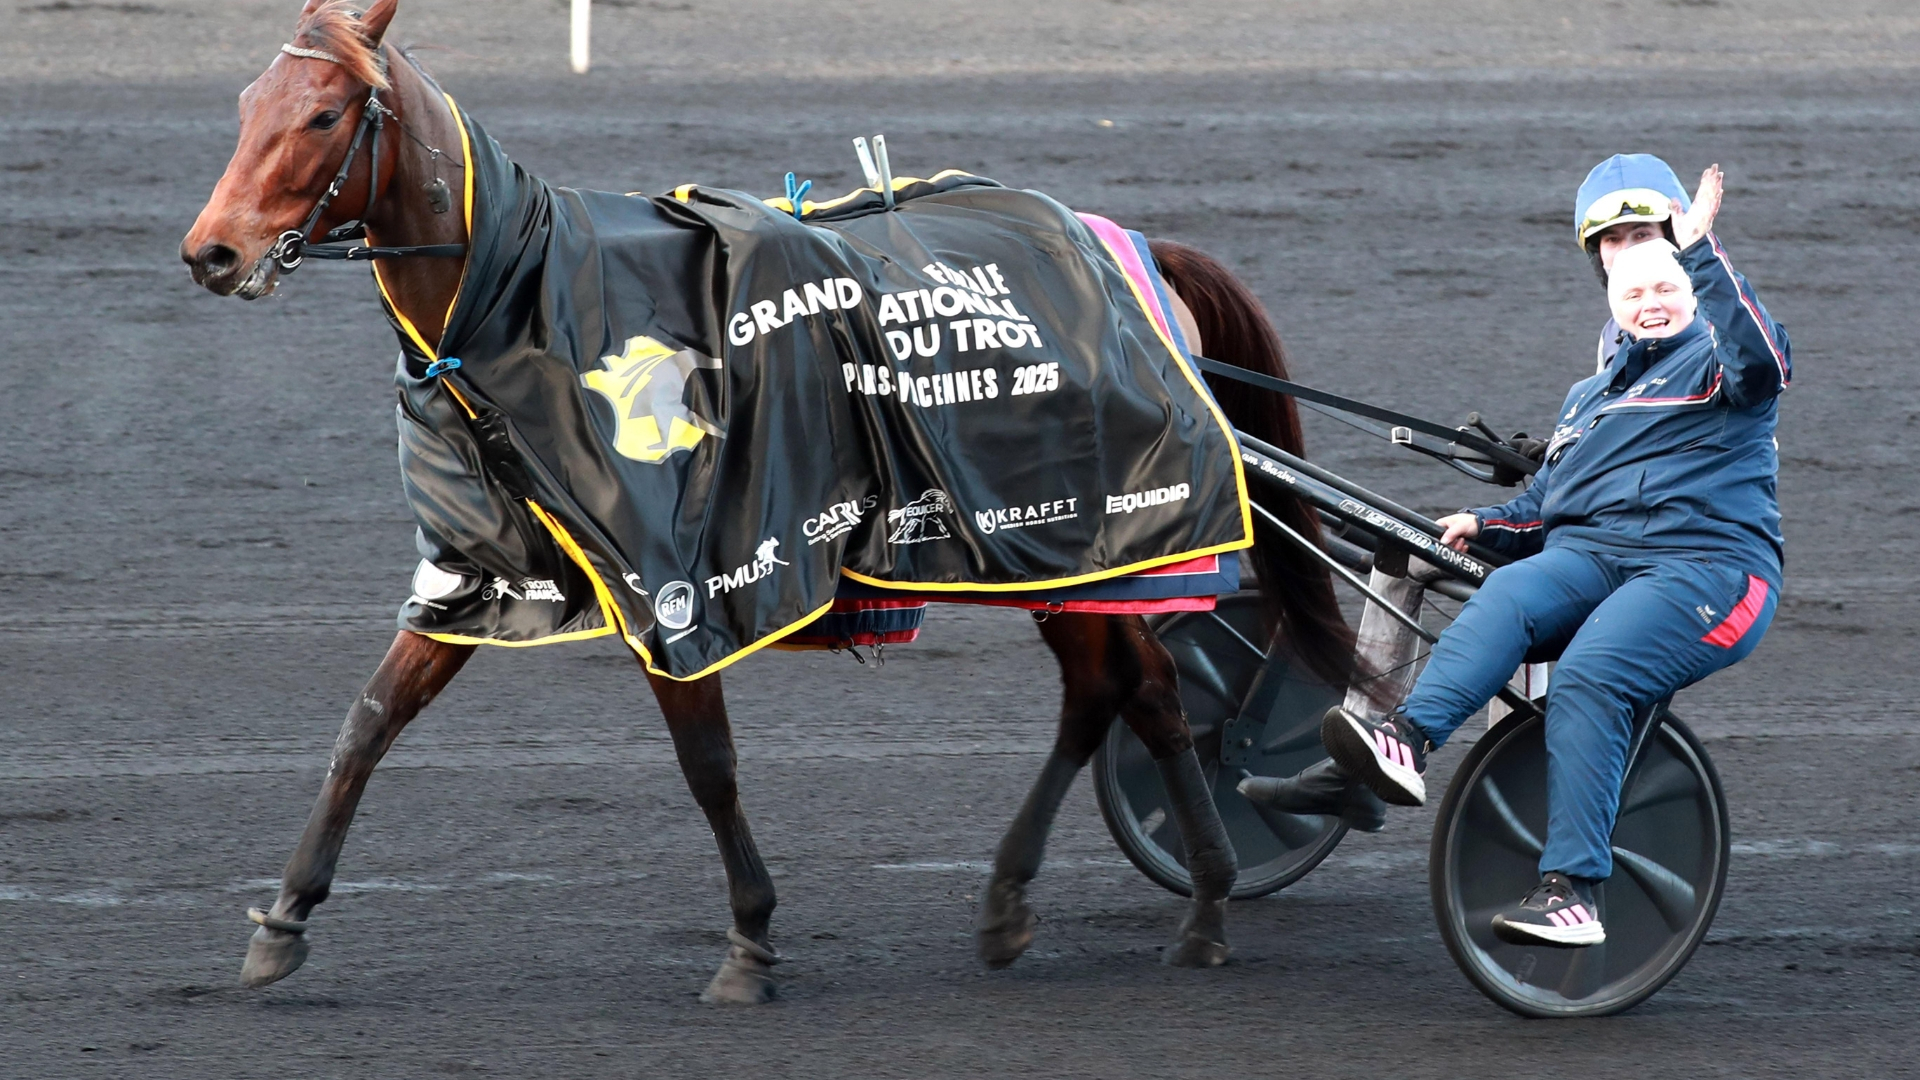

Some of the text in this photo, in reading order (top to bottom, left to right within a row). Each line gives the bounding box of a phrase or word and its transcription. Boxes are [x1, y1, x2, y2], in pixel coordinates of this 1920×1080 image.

[728, 277, 862, 346] GRAND
[885, 318, 1042, 361] DU TROT
[1011, 362, 1060, 395] 2025
[996, 498, 1077, 523] KRAFFT
[1105, 482, 1190, 514] EQUIDIA
[1433, 542, 1485, 578] YONKERS
[705, 560, 759, 599] PMU
[661, 595, 686, 617] RFM
